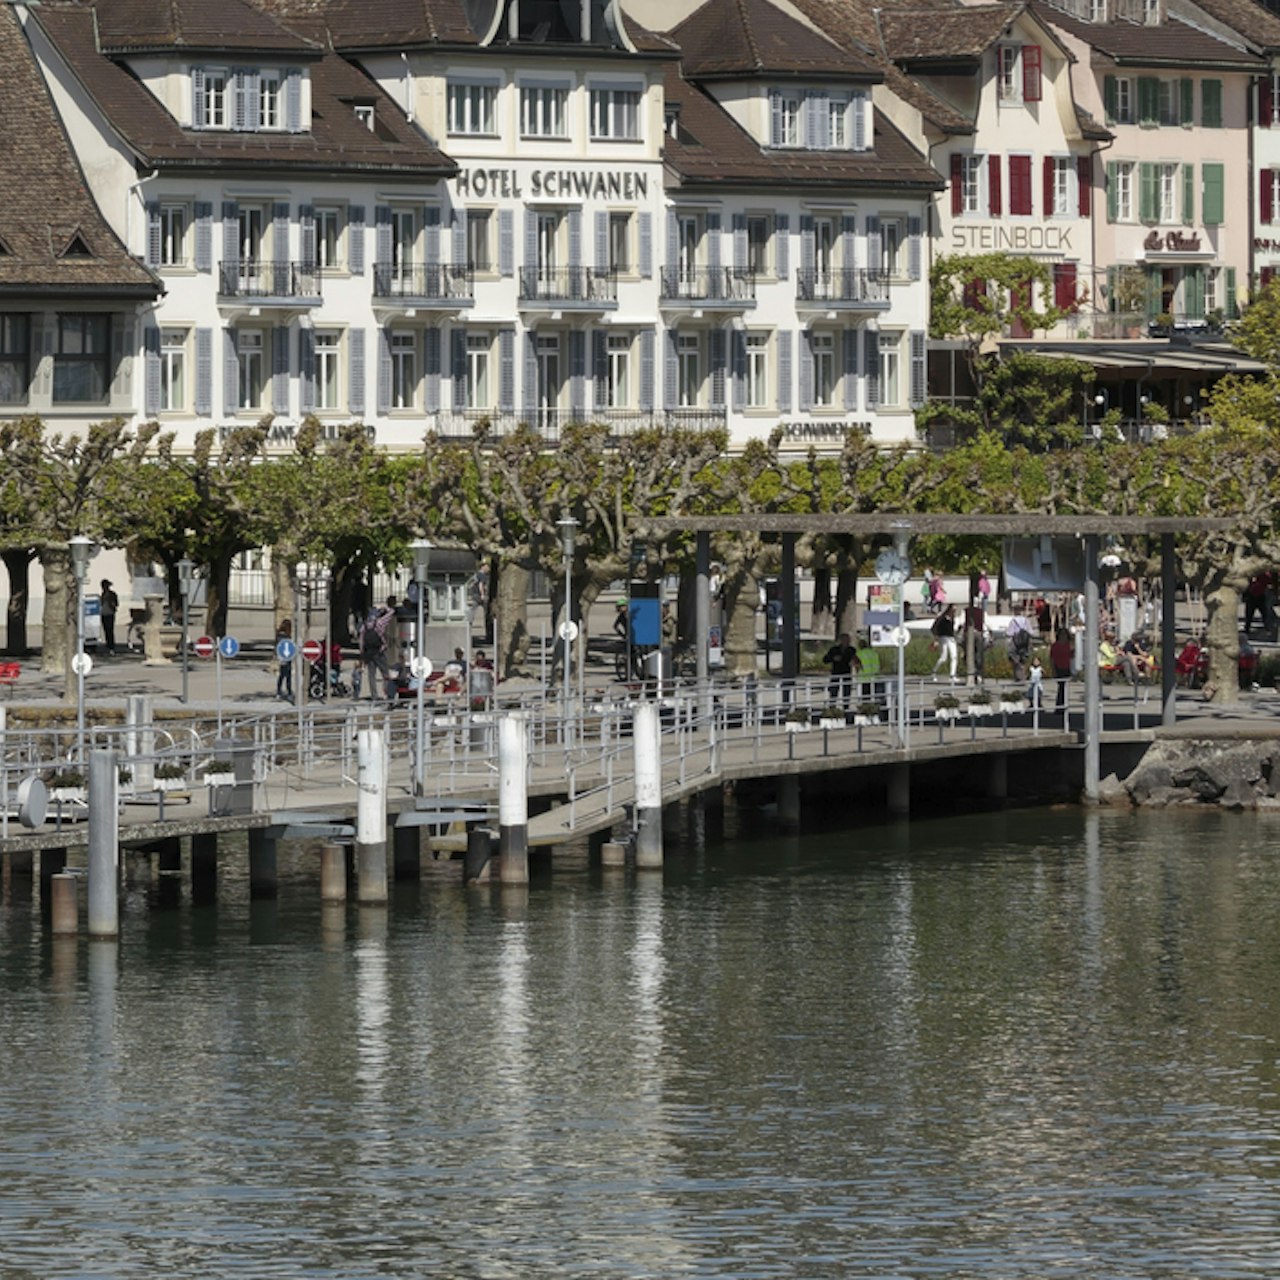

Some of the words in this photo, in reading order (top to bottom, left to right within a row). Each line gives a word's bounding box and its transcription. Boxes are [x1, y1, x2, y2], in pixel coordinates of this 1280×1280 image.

[456, 169, 522, 198] HOTEL
[531, 170, 647, 199] SCHWANEN
[952, 226, 1073, 250] STEINBOCK
